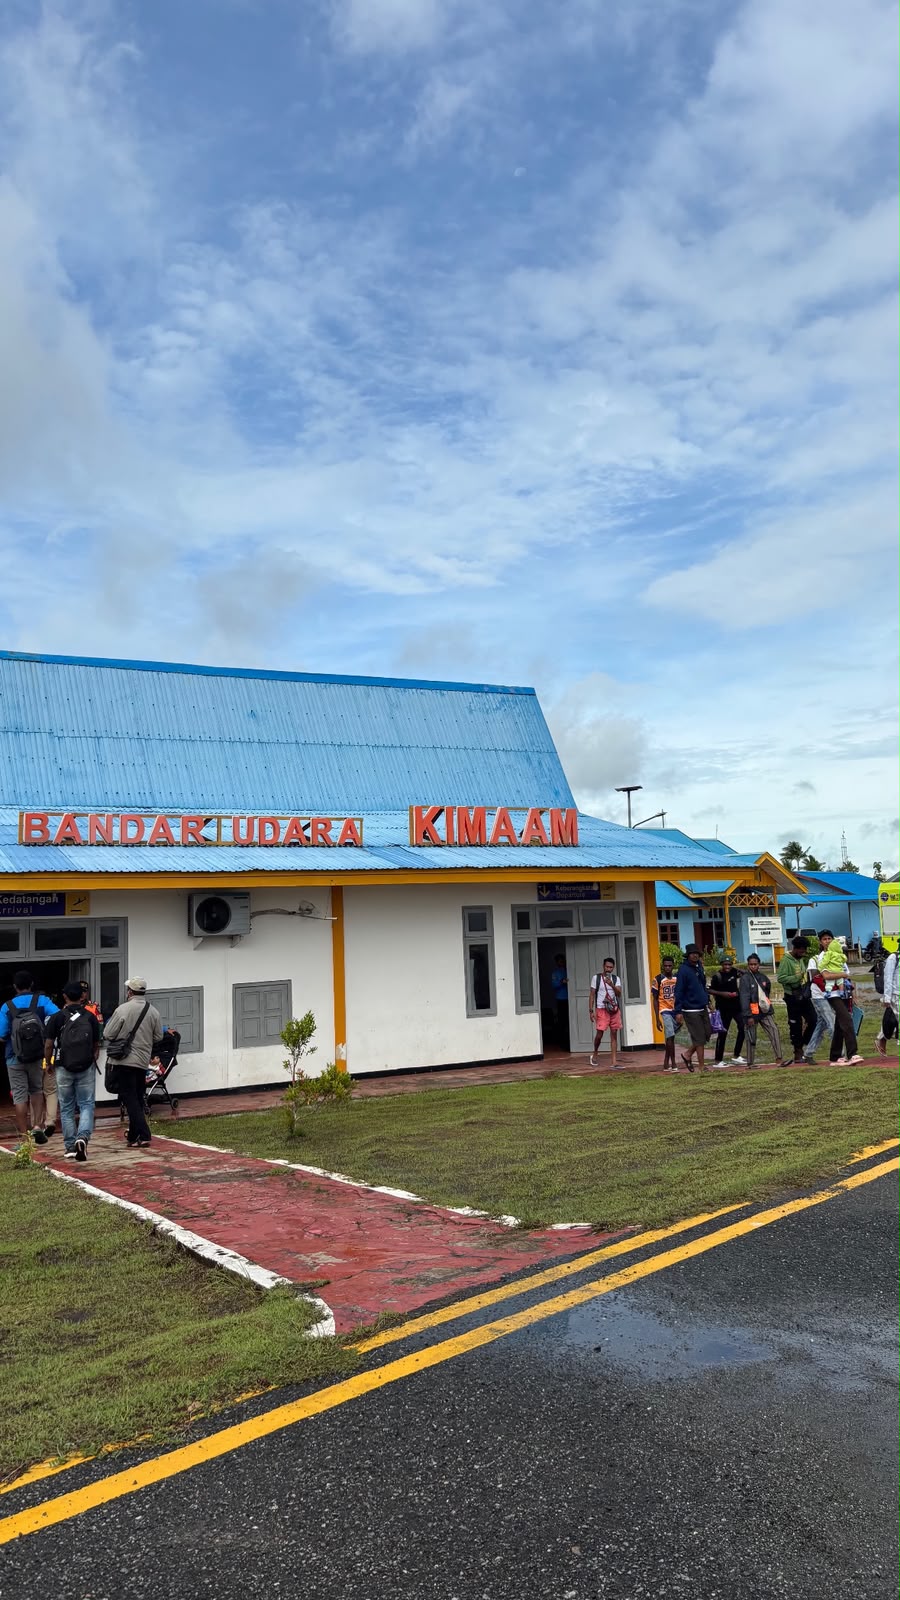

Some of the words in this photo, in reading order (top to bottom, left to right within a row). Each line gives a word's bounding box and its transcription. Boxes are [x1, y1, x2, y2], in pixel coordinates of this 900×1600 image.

[23, 812, 207, 846] BANDAR
[232, 815, 363, 847] UDARA
[413, 805, 579, 847] KIMAAM
[0, 905, 33, 915] rrival
